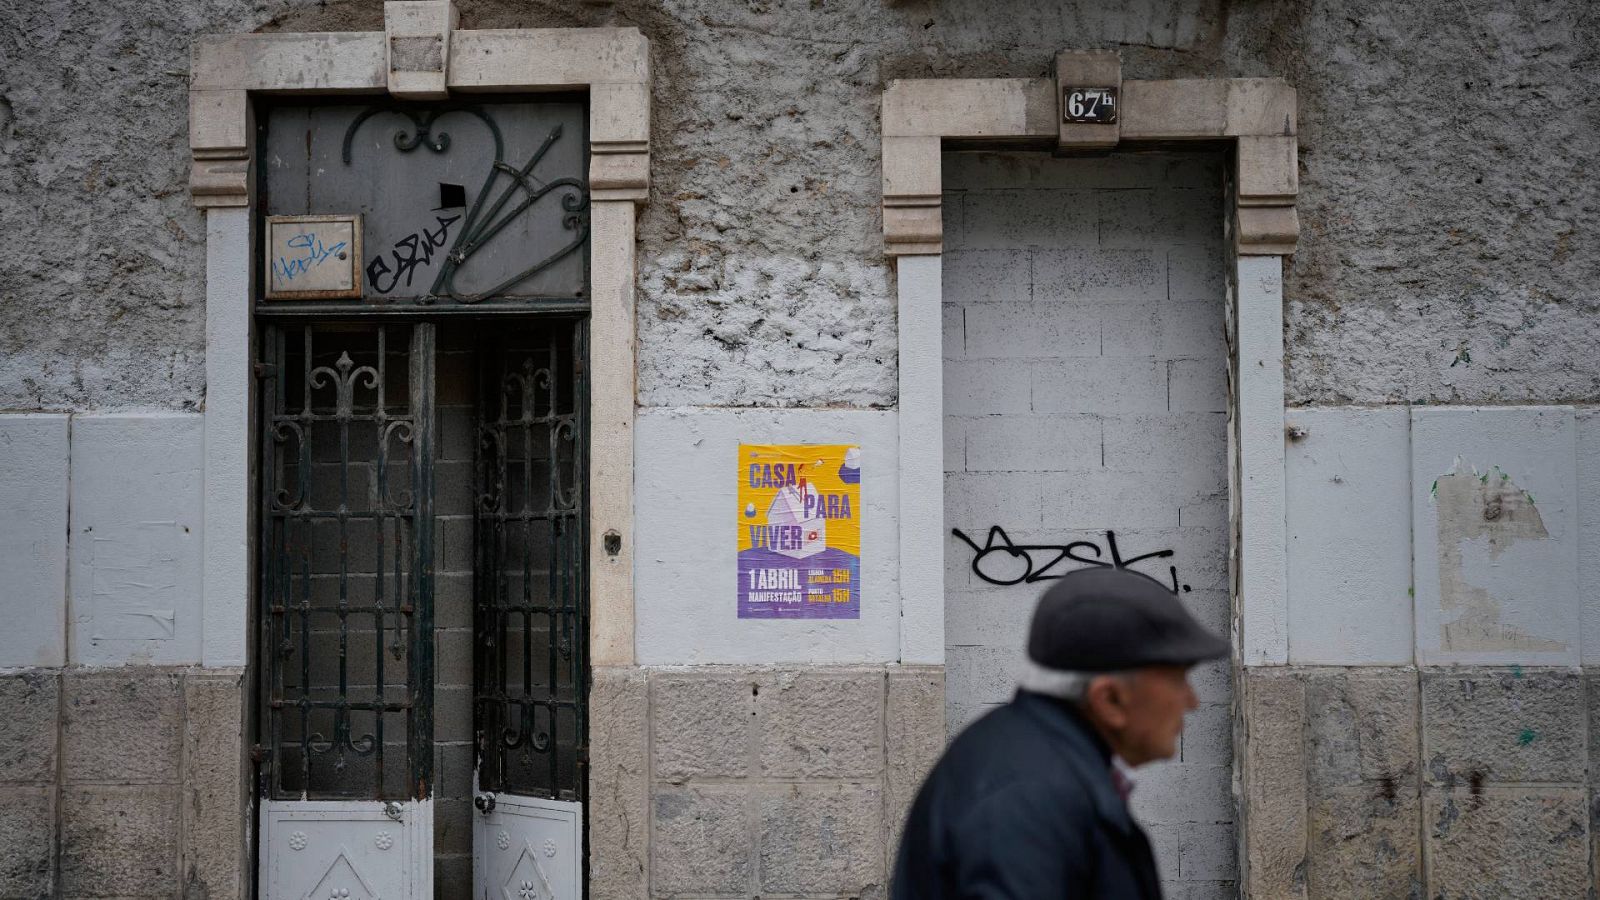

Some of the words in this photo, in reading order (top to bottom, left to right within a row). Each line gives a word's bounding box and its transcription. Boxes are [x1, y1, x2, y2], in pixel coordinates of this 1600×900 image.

[749, 463, 797, 488] CASA
[803, 494, 851, 519] PARA
[750, 525, 803, 551] VIVER
[748, 569, 756, 590] 1
[758, 568, 802, 590] ABRIL
[748, 590, 802, 604] MANIFESTAÇÃO
